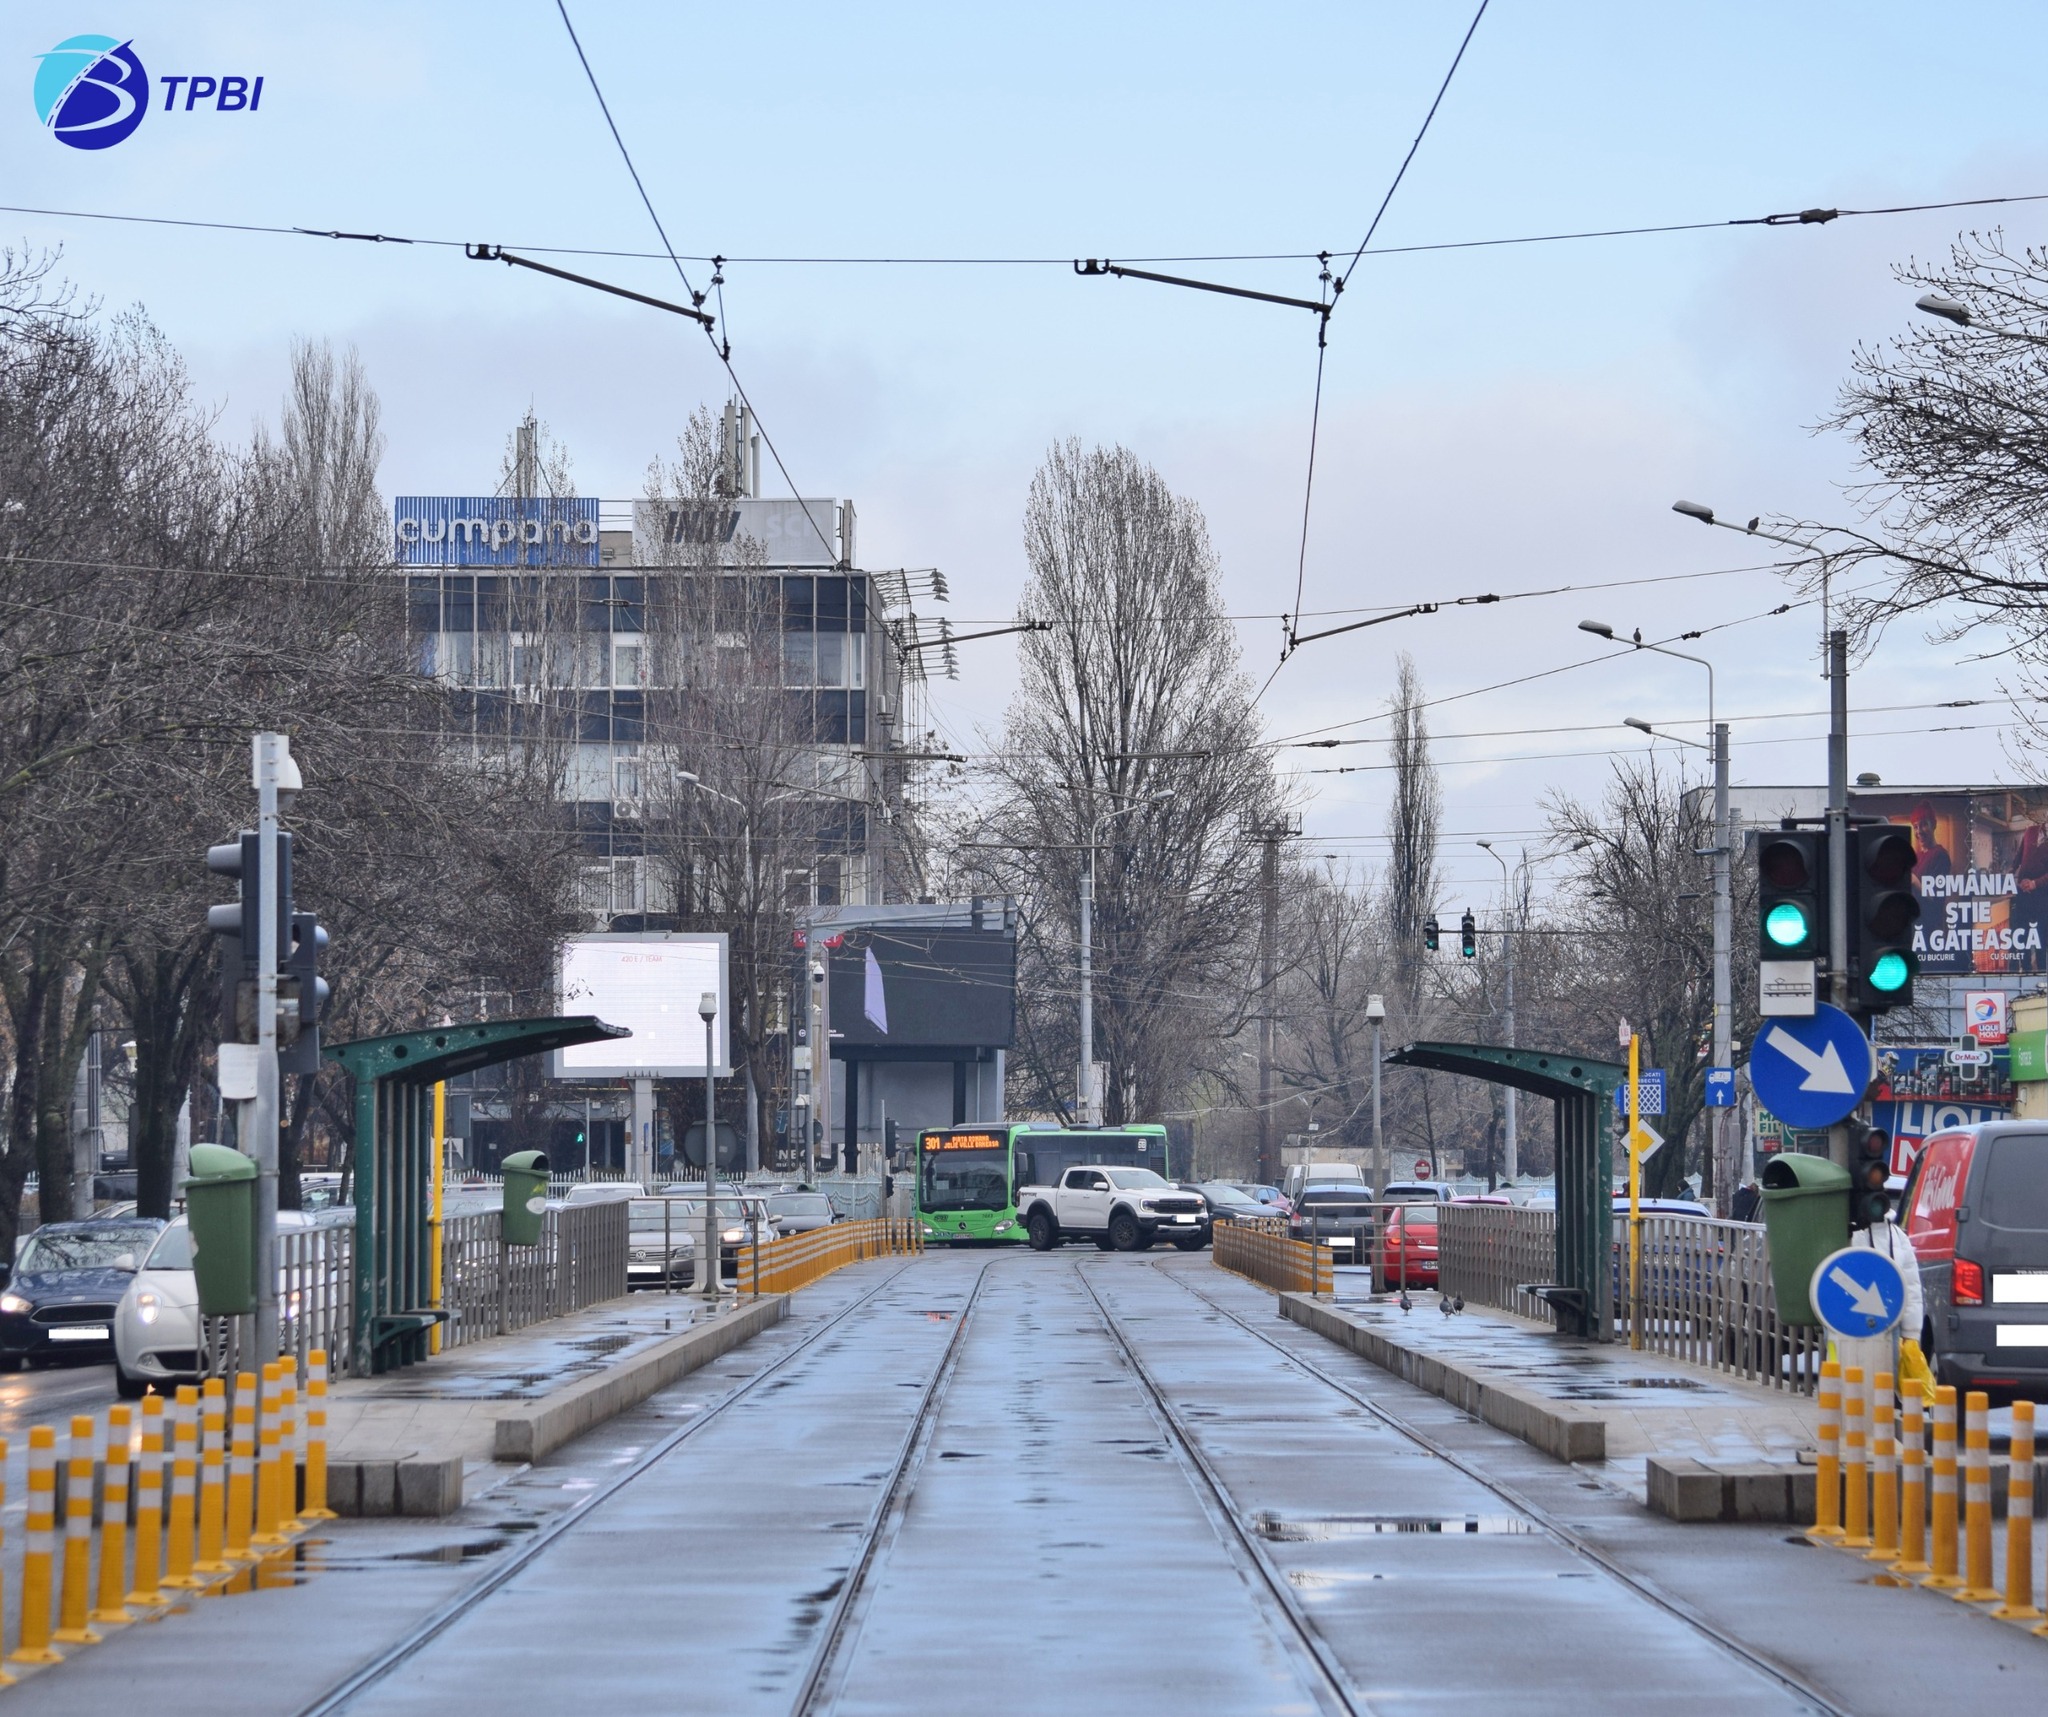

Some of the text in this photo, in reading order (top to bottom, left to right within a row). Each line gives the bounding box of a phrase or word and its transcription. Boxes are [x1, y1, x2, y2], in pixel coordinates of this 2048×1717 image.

[1921, 868, 2018, 897] ROMÂNIA
[1929, 922, 2042, 952] GĂTEASCĂ
[1917, 953, 1955, 961] CU BUCURIE
[1990, 952, 2024, 960] CU SUFLET
[1954, 1053, 1980, 1061] Dr.Max
[925, 1137, 940, 1150] 301
